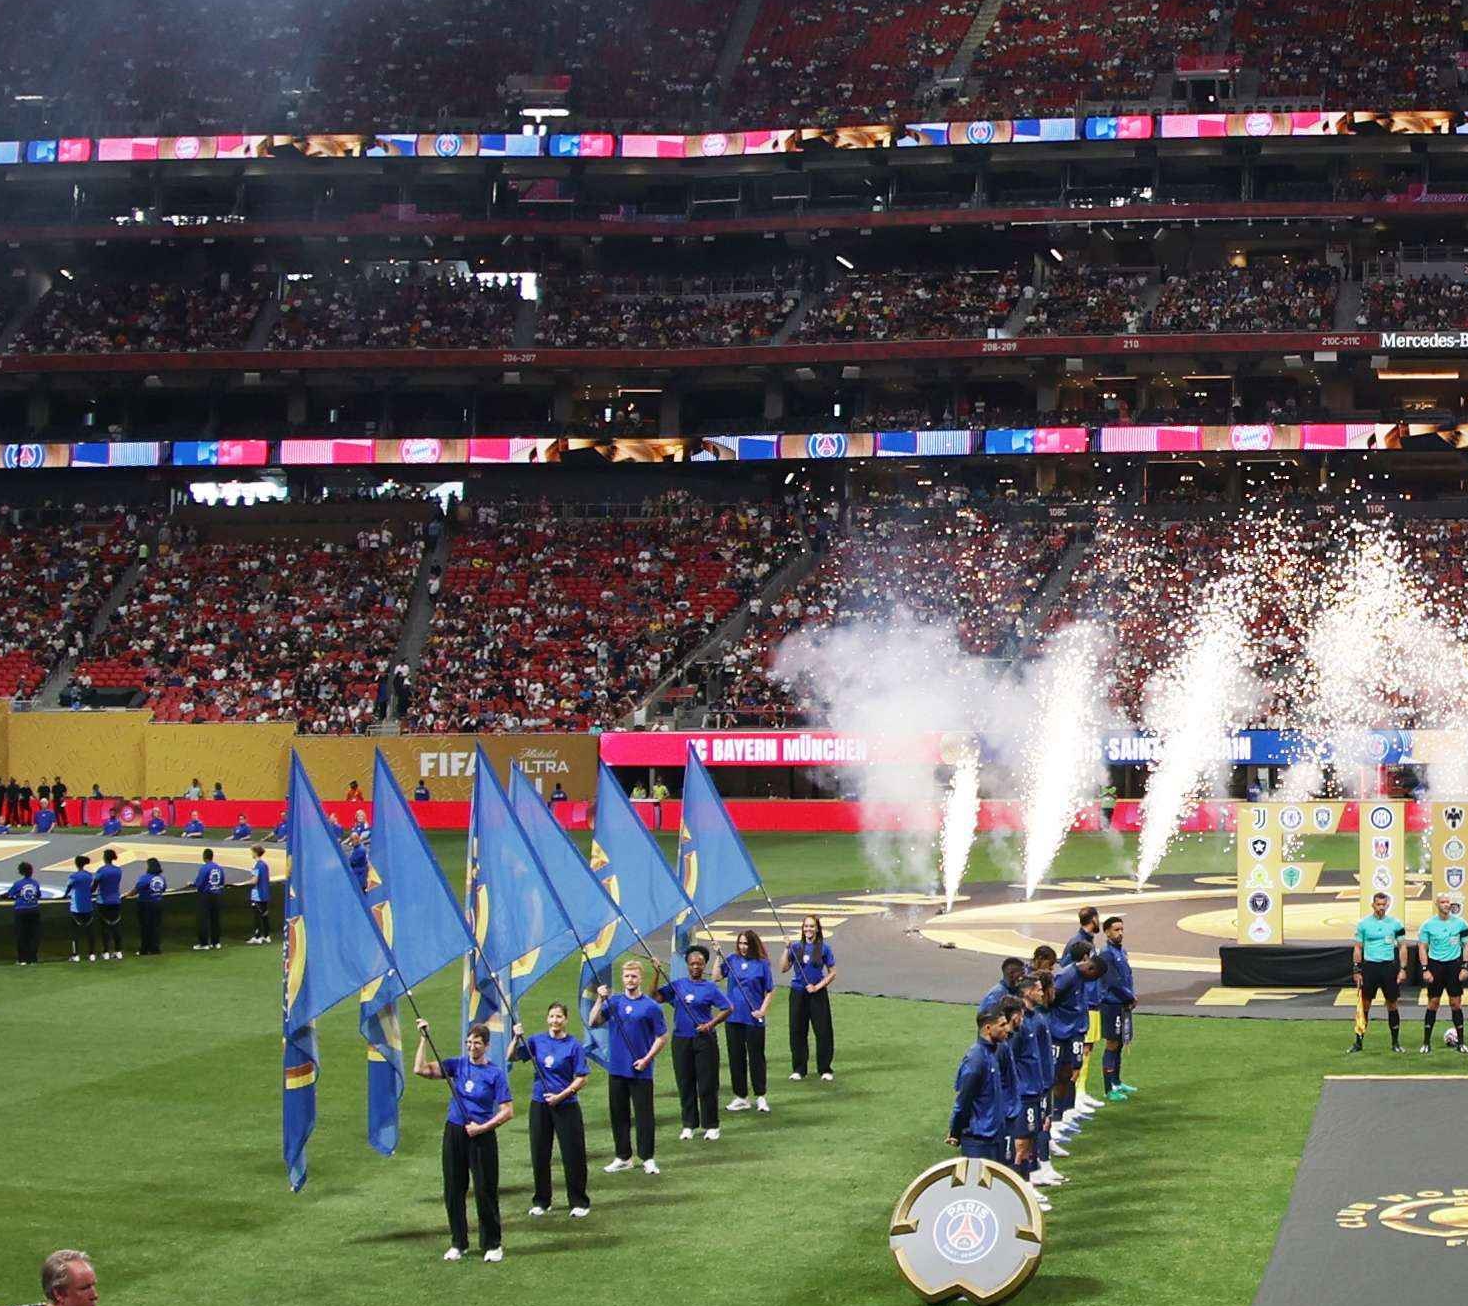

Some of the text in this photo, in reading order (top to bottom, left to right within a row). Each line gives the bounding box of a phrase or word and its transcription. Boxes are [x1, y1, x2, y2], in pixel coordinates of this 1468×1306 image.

[1123, 338, 1139, 348] 210
[711, 738, 777, 762] BAYERN
[781, 733, 867, 762] MÜNCHEN
[1027, 1108, 1034, 1123] 8
[947, 1203, 989, 1220] PARIS
